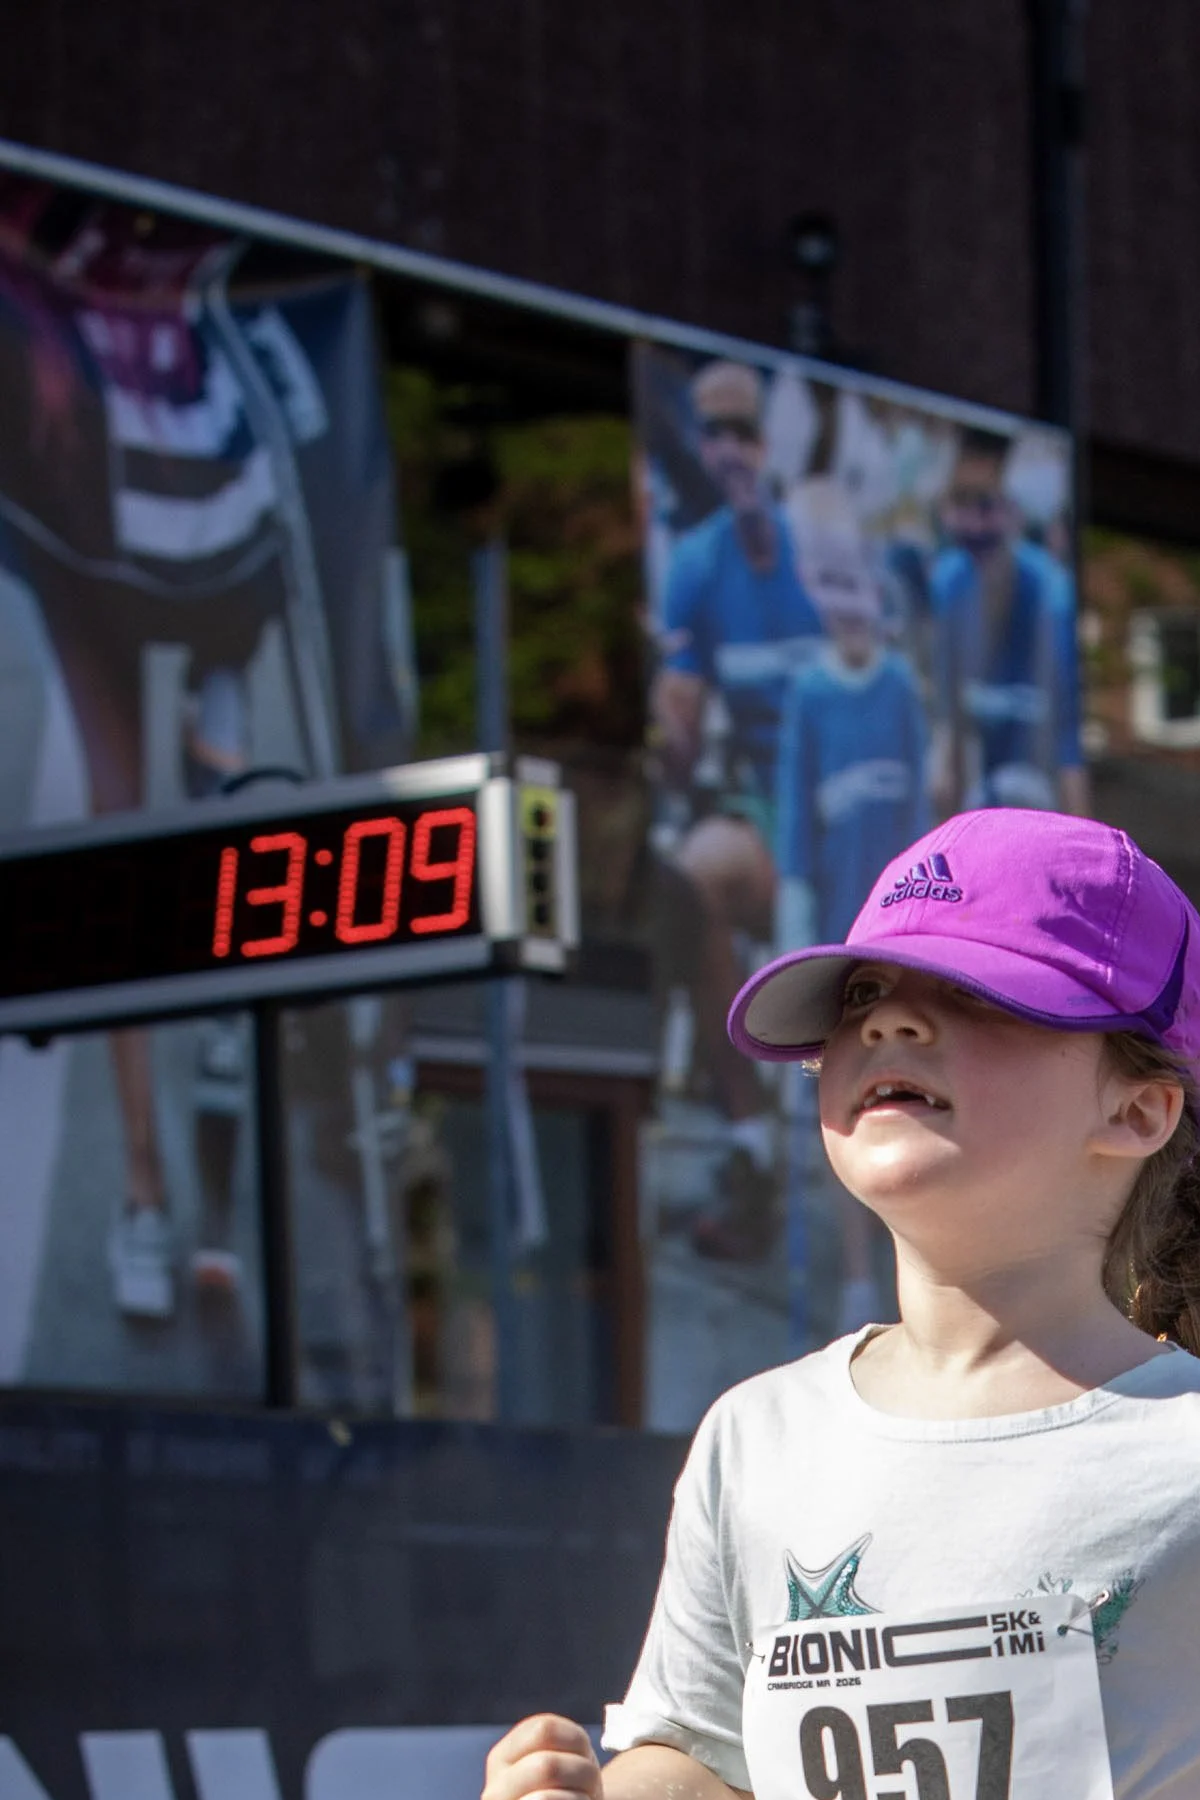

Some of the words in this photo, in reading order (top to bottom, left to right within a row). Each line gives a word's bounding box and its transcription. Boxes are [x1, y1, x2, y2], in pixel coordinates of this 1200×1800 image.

[211, 806, 477, 960] 13:09
[880, 880, 963, 907] adidas
[768, 1615, 992, 1677] BIONIC
[990, 1610, 1043, 1634] 5K&
